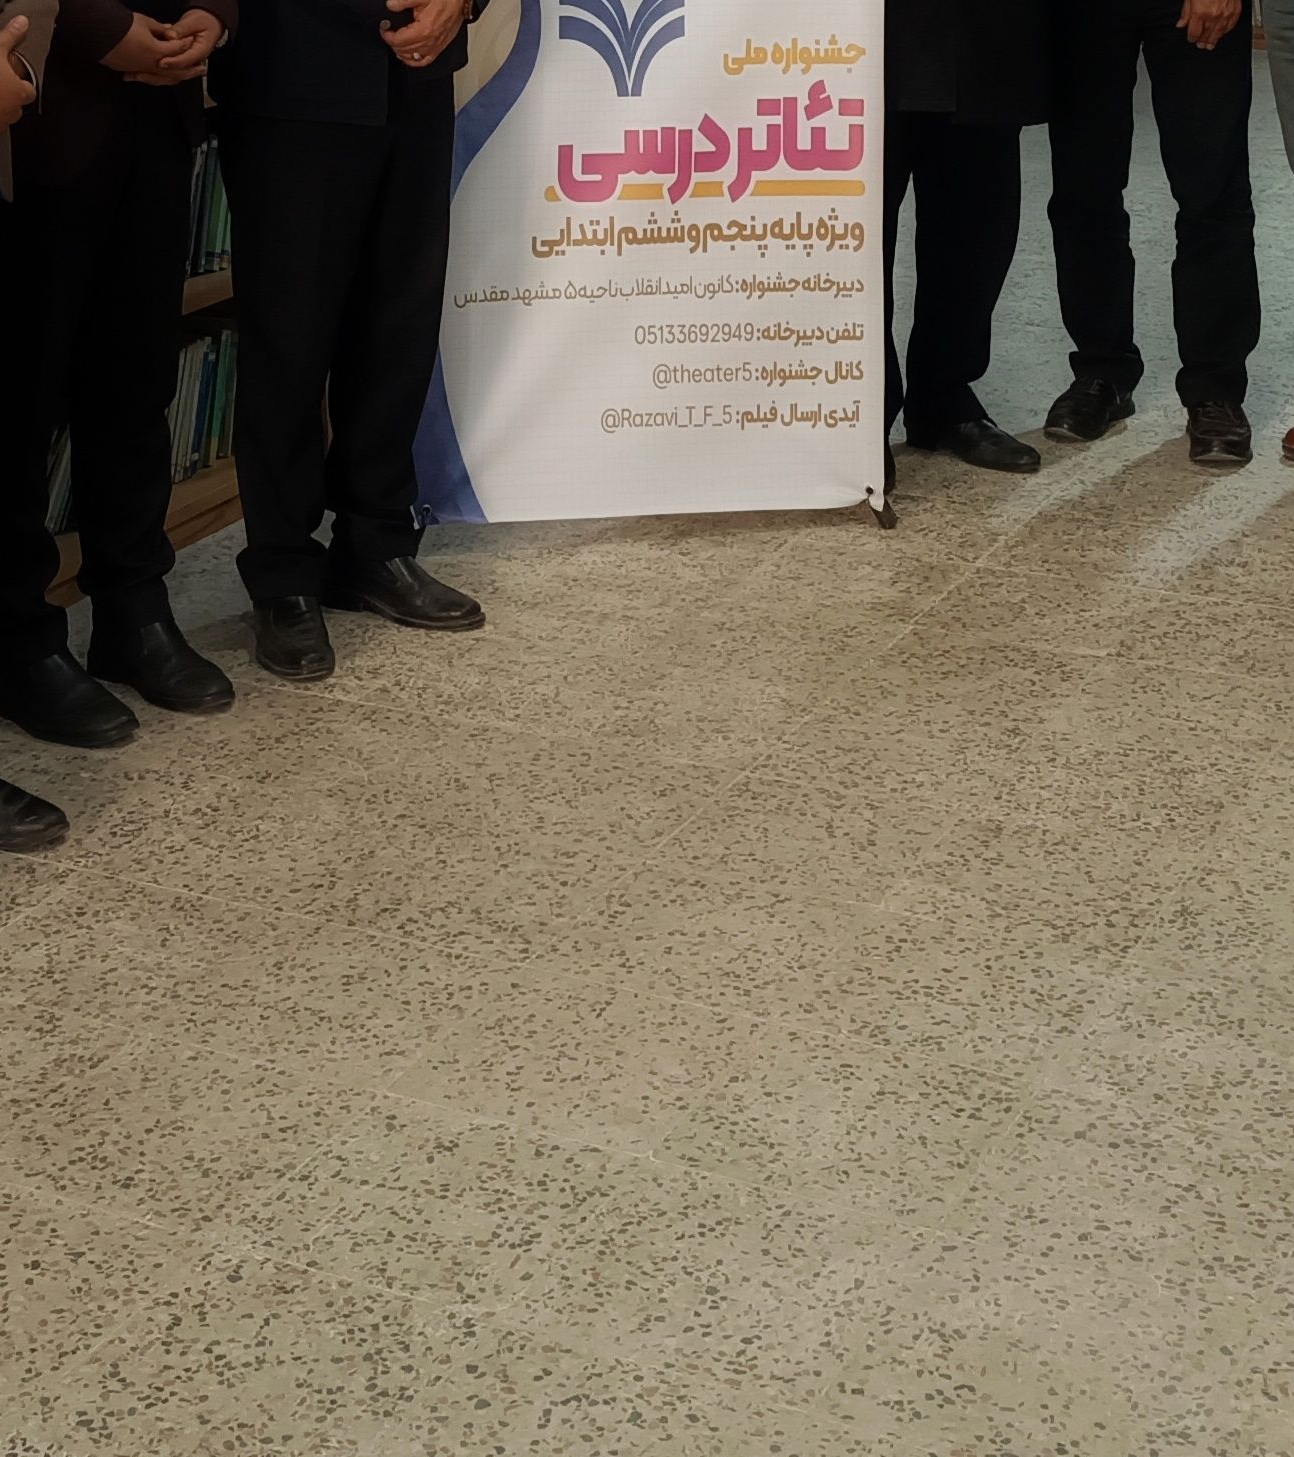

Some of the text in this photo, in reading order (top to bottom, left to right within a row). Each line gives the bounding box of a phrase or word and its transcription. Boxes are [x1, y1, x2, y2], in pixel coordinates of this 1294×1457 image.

[723, 34, 866, 75] جشنواره ملی
[557, 79, 866, 204] تئاتر درسی
[531, 215, 615, 258] ابتدایی
[617, 210, 686, 256] ششم
[702, 215, 768, 258] پنجم
[769, 211, 814, 257] پایه
[815, 207, 865, 250] ویژه
[454, 285, 510, 308] مقدس
[511, 281, 562, 306] مشهد
[578, 279, 619, 303] ناحیه
[694, 274, 734, 300] کانون
[801, 272, 865, 298] دبیرخانه
[634, 323, 755, 345] 05133692949
[825, 322, 864, 344] تلفن
[652, 362, 753, 390] @theater5
[824, 360, 864, 385] کانال
[601, 404, 733, 433] @Razavi_T_F_5
[780, 403, 822, 429] ارسال
[823, 400, 861, 428] آیدی
